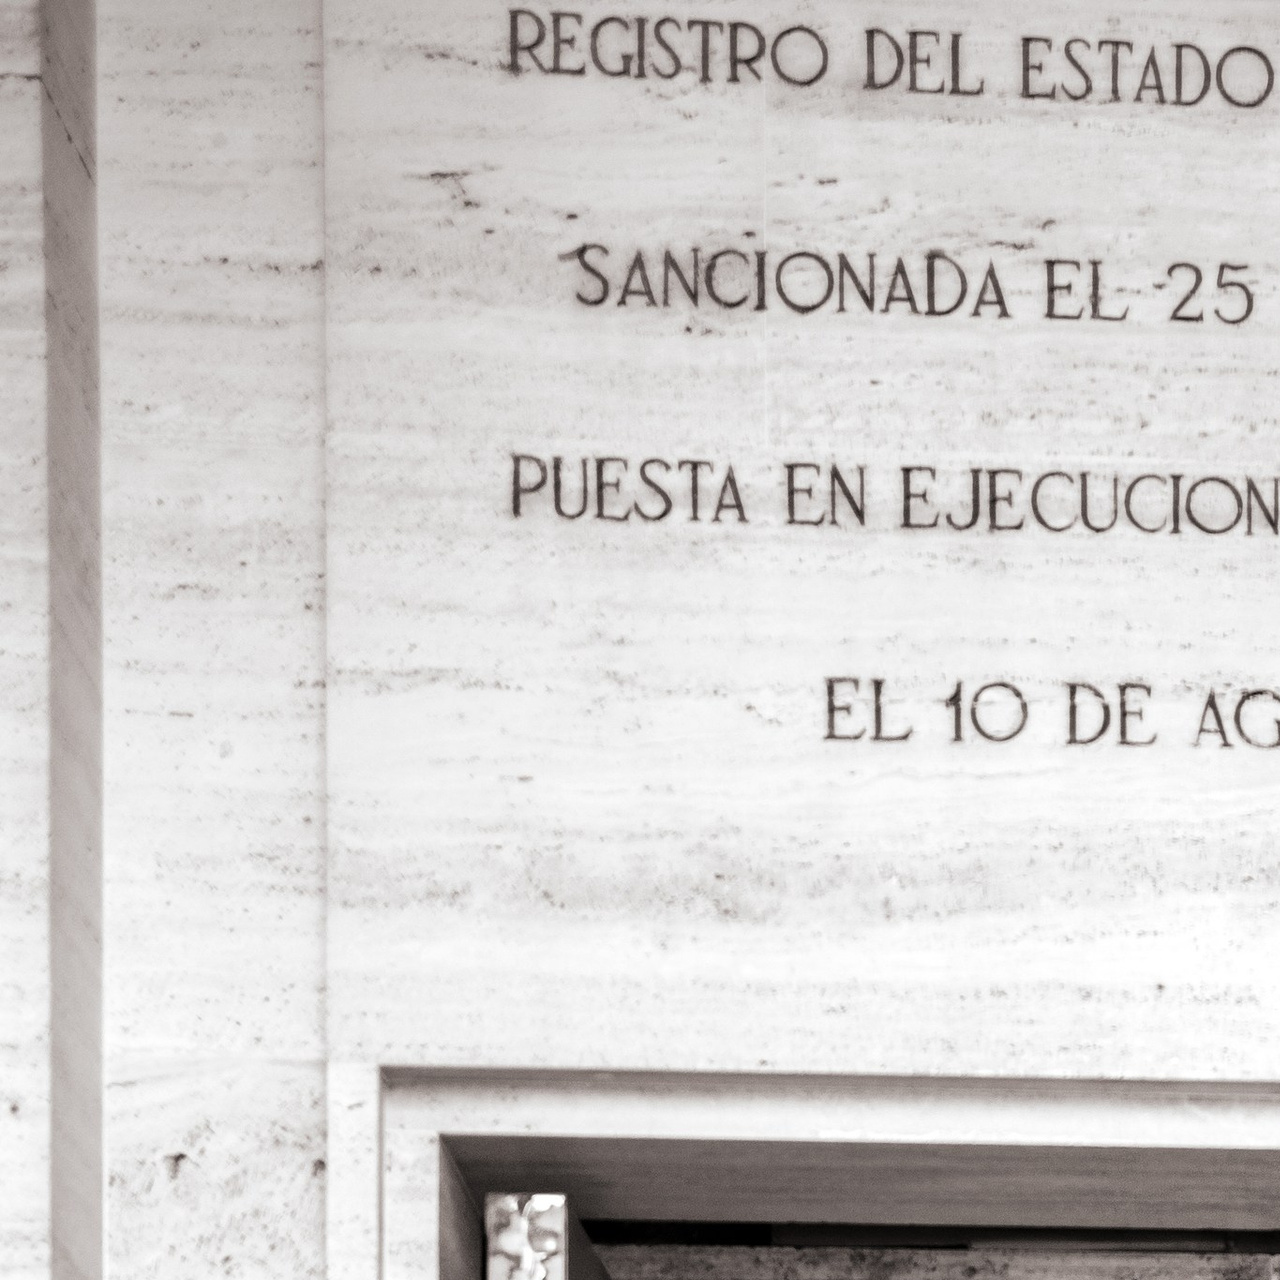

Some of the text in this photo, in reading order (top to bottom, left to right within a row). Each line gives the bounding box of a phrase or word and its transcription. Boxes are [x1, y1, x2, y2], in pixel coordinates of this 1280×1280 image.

[507, 10, 829, 87] REGISTRO
[863, 27, 985, 97] DEL
[1020, 37, 1275, 108] ESTADO
[574, 243, 1012, 319] SANCIONADA
[1044, 258, 1129, 322] EL
[1166, 262, 1254, 325] 25
[510, 453, 749, 524] PUESTA
[784, 462, 866, 527] EN
[823, 677, 913, 743] EL
[944, 680, 1029, 743] 10
[1065, 681, 1156, 747] DE
